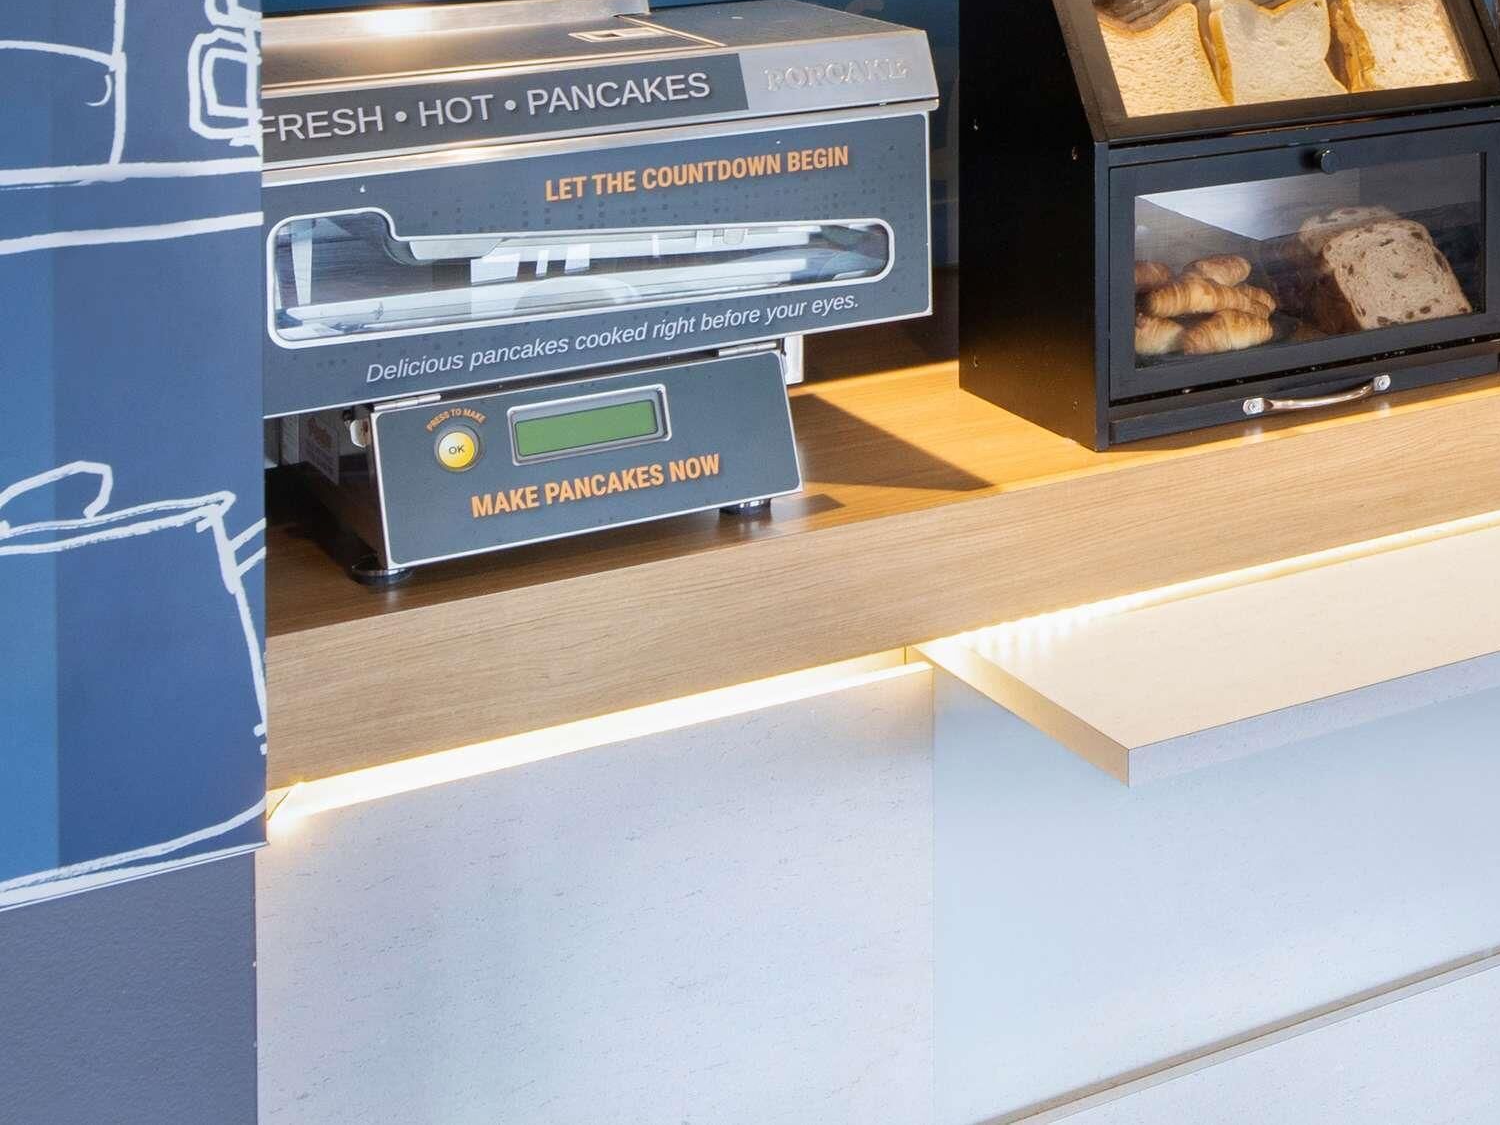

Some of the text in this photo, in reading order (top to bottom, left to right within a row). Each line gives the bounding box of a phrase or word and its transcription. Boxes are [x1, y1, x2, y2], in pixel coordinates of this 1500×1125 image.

[262, 72, 710, 142] FRESH HOT PANCAKES
[545, 145, 849, 202] LET THE COUNTDOWN BEGIN
[366, 294, 859, 383] Delicious pancakes cooked right before your eyes.
[426, 407, 486, 432] PRESS TO MAKE
[448, 444, 466, 454] OK
[471, 453, 720, 518] MAKE PANCAKES NOW
